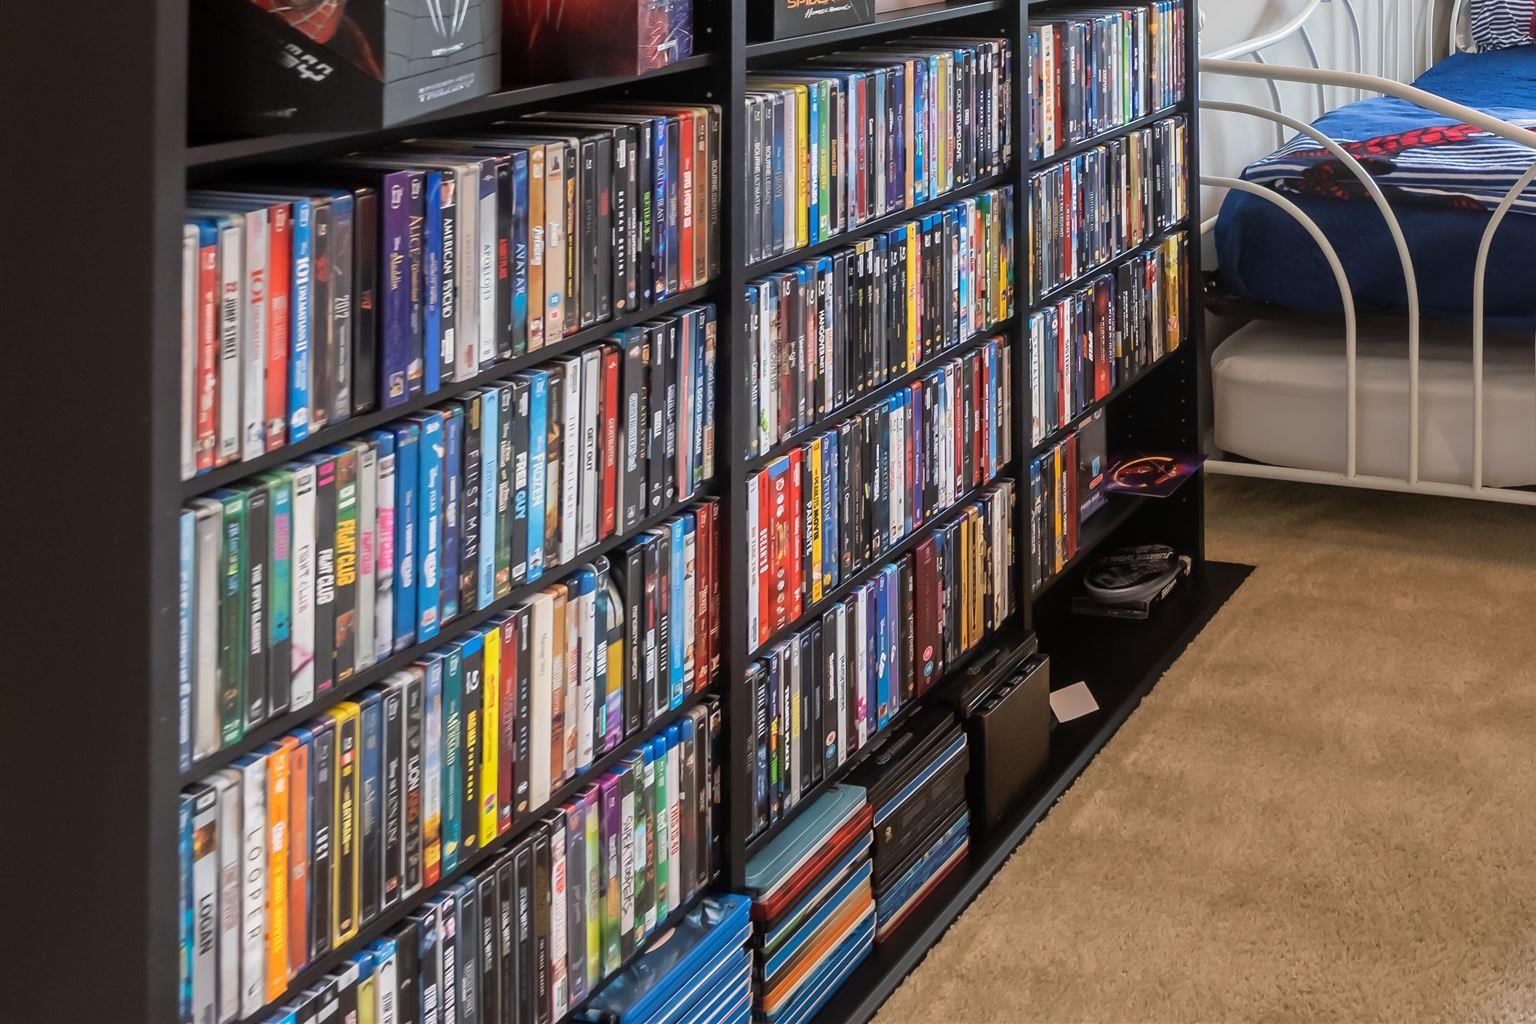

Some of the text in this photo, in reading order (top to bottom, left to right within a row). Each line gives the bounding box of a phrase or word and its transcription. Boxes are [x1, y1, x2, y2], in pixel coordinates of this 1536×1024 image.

[657, 158, 665, 190] BEAUTY
[684, 170, 693, 188] BIG
[711, 159, 719, 226] BOURNE IDENTITY
[753, 174, 761, 217] ULTIMATUM
[408, 216, 424, 256] ALICE
[296, 256, 310, 285] 101
[442, 218, 454, 319] AMERICAN PSYCHO
[515, 243, 526, 297] AVATAR
[617, 237, 625, 278] BEGINS
[334, 295, 350, 321] 2012
[696, 387, 704, 414] GOOD
[707, 381, 715, 400] Luck
[707, 402, 715, 426] Chuck
[586, 427, 594, 450] GET
[696, 416, 704, 456] DINOSAUR
[515, 451, 528, 520] FREE GUY
[532, 452, 546, 508] FROZEN
[824, 474, 832, 503] PETER
[464, 449, 479, 560] FIRST MAN
[336, 517, 356, 587] FIGHT CLUB
[760, 528, 769, 563] OCEAN'S
[316, 547, 334, 606] FIGHT CLUB
[401, 555, 413, 587] NEMO
[424, 551, 437, 587] NEMO
[597, 640, 607, 679] MIDWAY
[520, 677, 528, 701] MAN
[757, 682, 766, 709] TOTAL
[407, 762, 420, 792] LION
[670, 800, 680, 828] THIS
[647, 814, 655, 866] TAKEN
[670, 829, 679, 841] IS
[622, 814, 634, 917] SUPER TROOPERS
[246, 826, 264, 943] LOOPER
[199, 893, 214, 957] LOGAN
